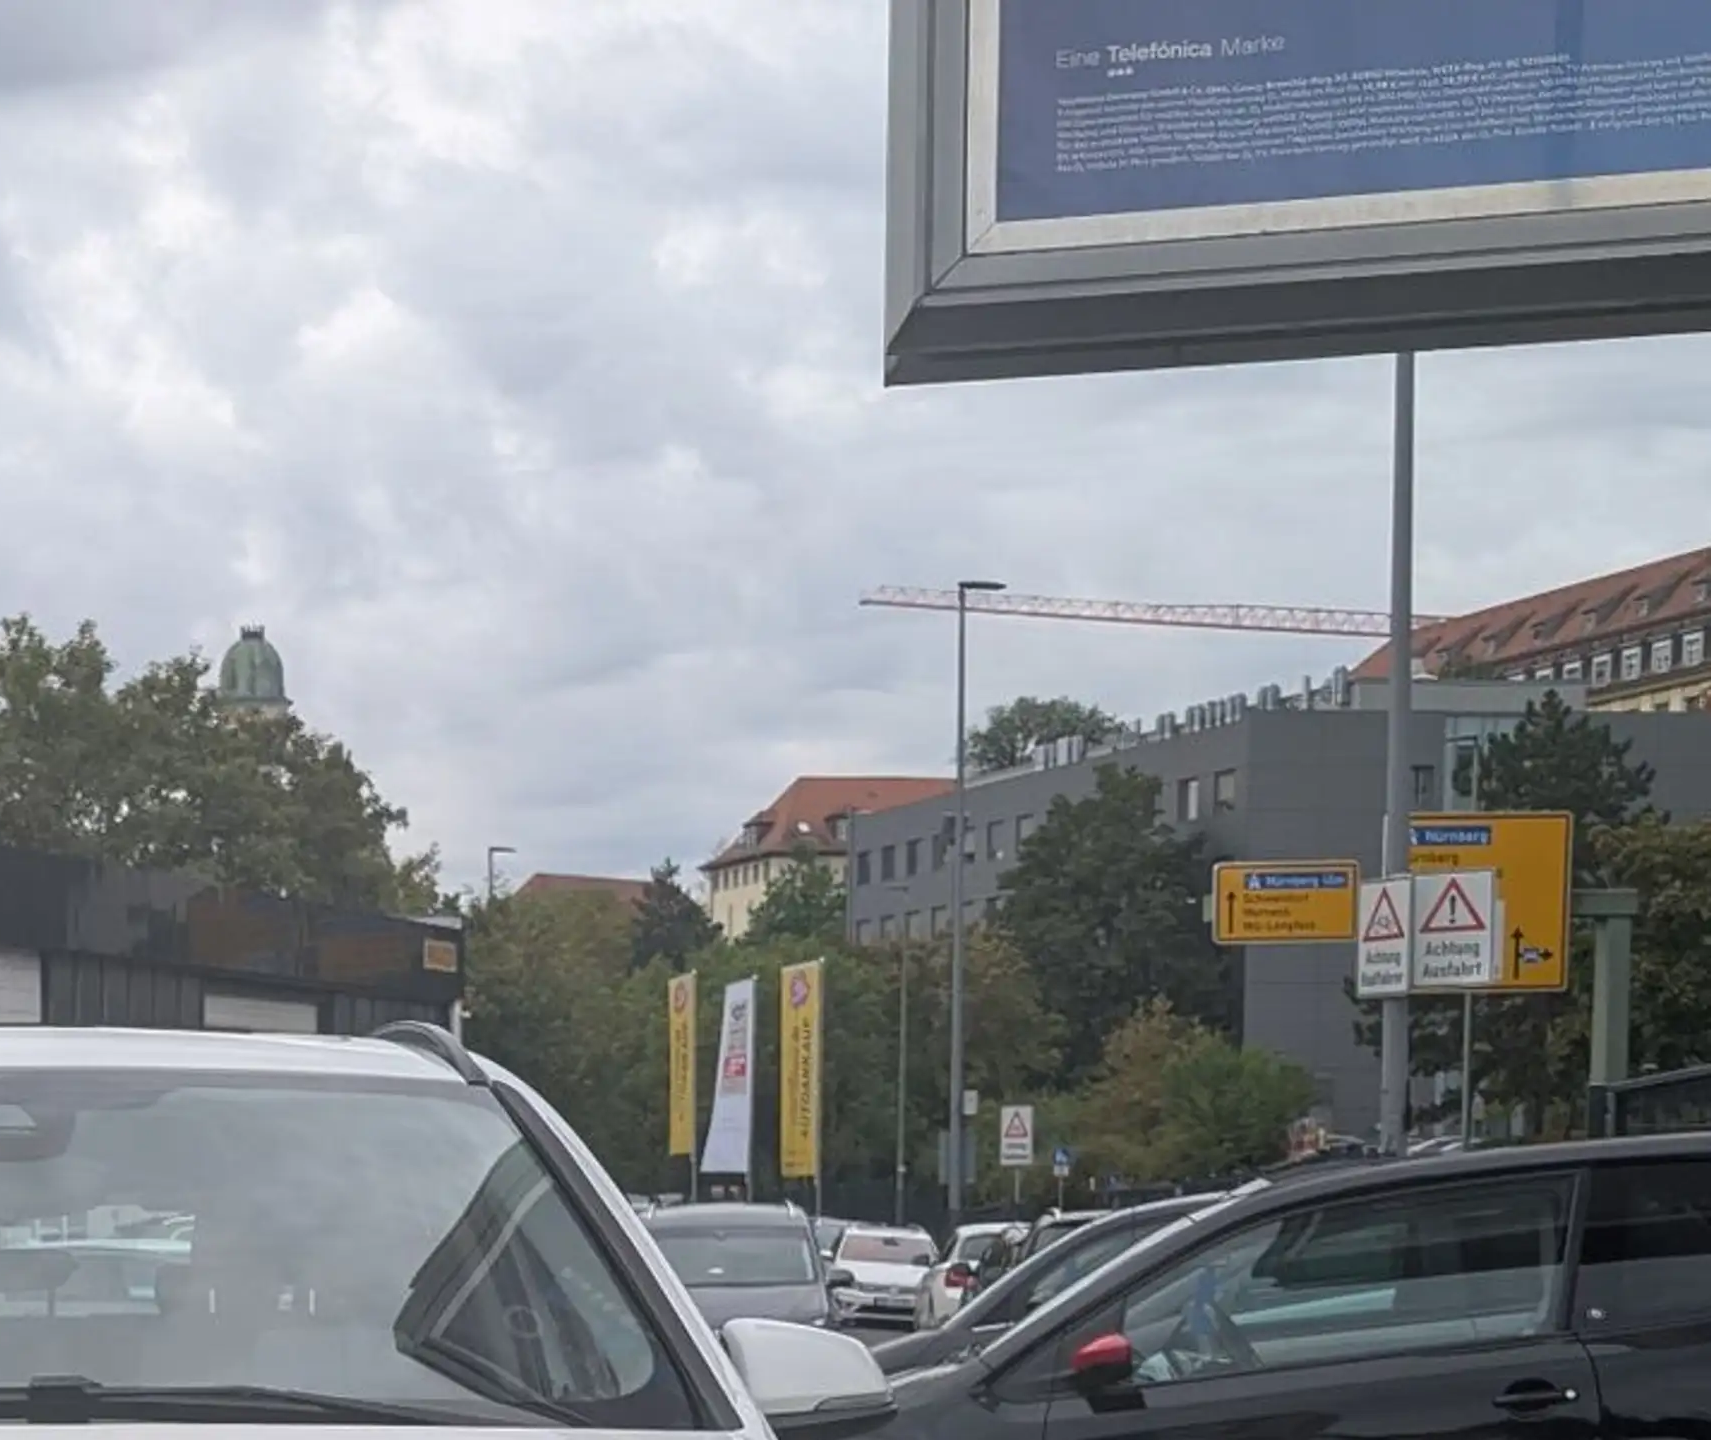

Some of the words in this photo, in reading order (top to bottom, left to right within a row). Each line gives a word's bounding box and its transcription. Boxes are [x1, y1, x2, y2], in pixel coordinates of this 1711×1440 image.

[1055, 49, 1100, 69] Eine
[1107, 40, 1212, 63] Telefónica
[1220, 34, 1286, 57] Marke
[1425, 941, 1481, 957] Achtung
[1423, 961, 1482, 978] Ausfahrt
